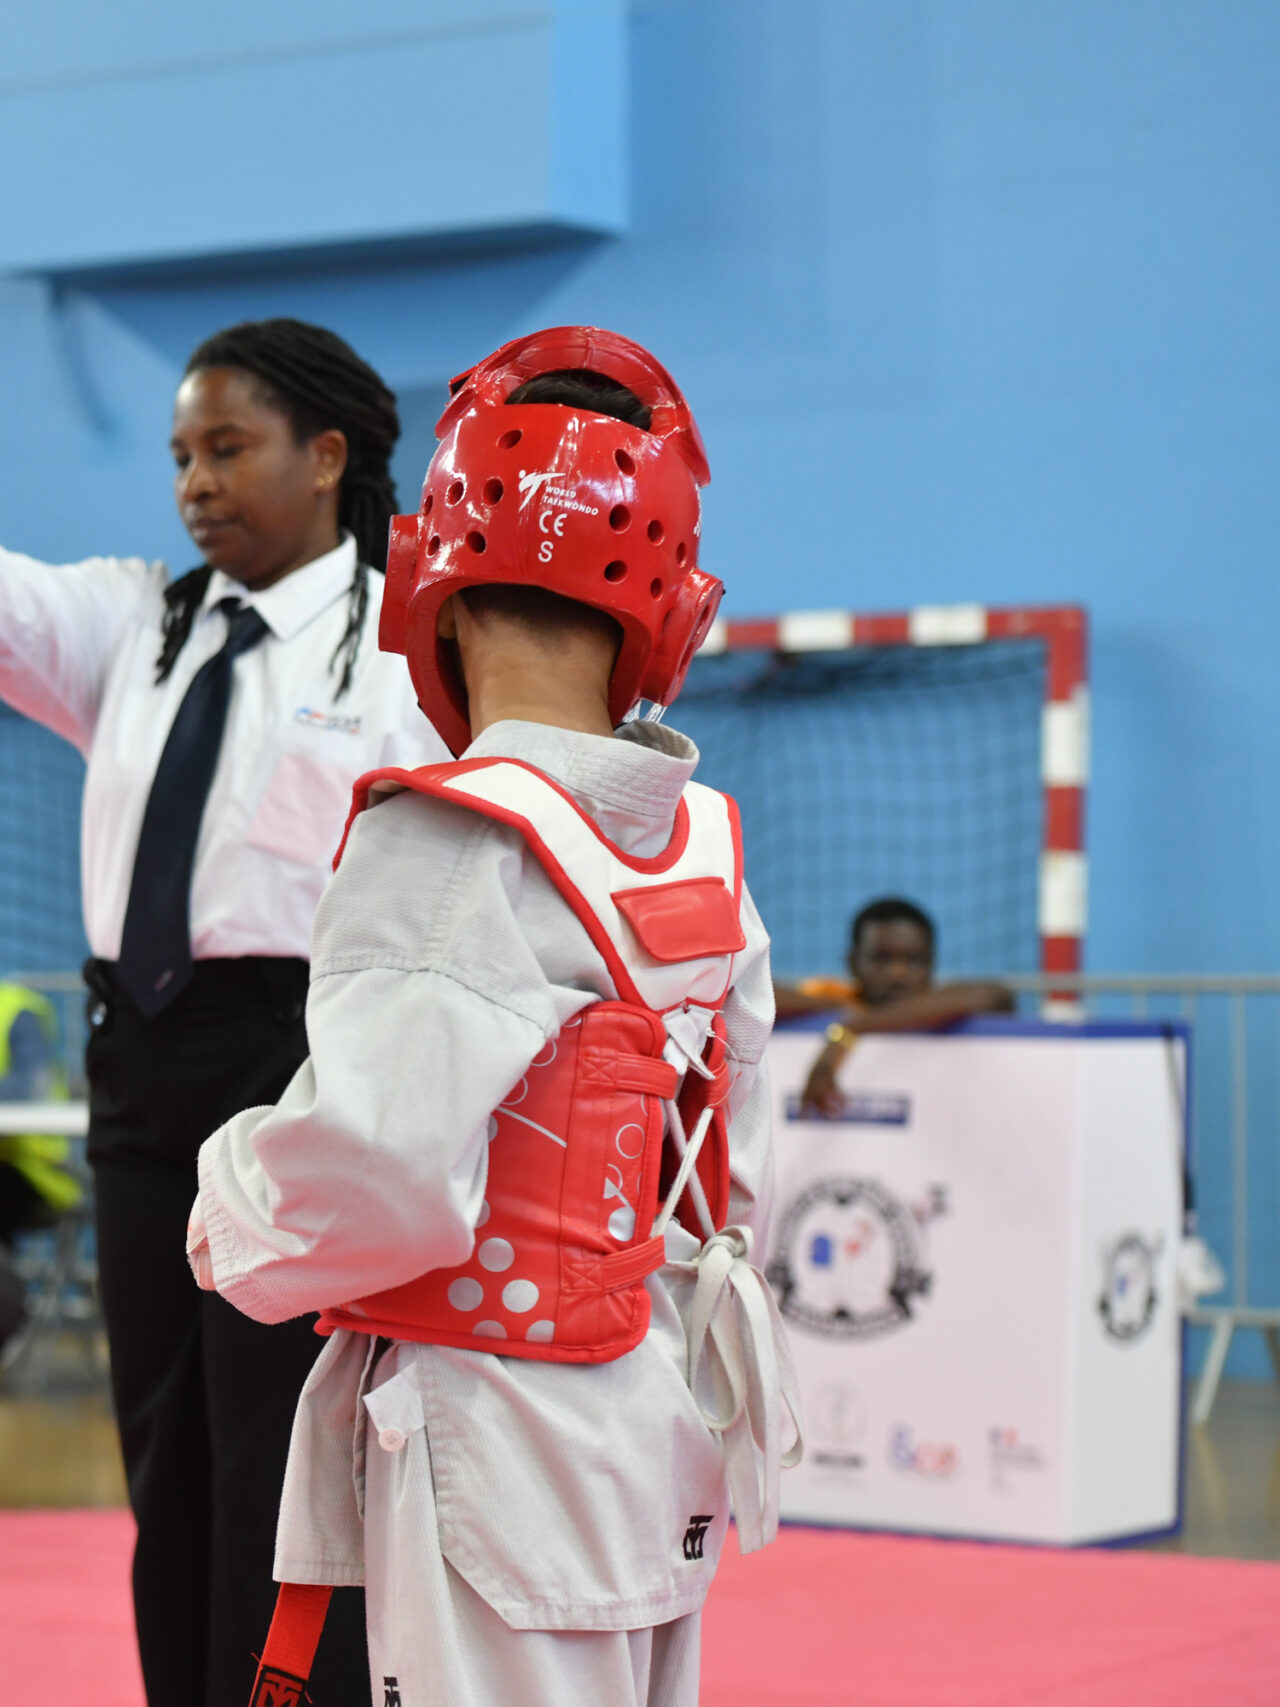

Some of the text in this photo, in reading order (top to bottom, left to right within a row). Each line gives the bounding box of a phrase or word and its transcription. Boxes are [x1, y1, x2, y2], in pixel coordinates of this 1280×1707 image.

[545, 485, 577, 499] WORLD
[543, 495, 599, 516] TAEKWONDO
[538, 510, 568, 537] CE
[537, 540, 554, 563] S
